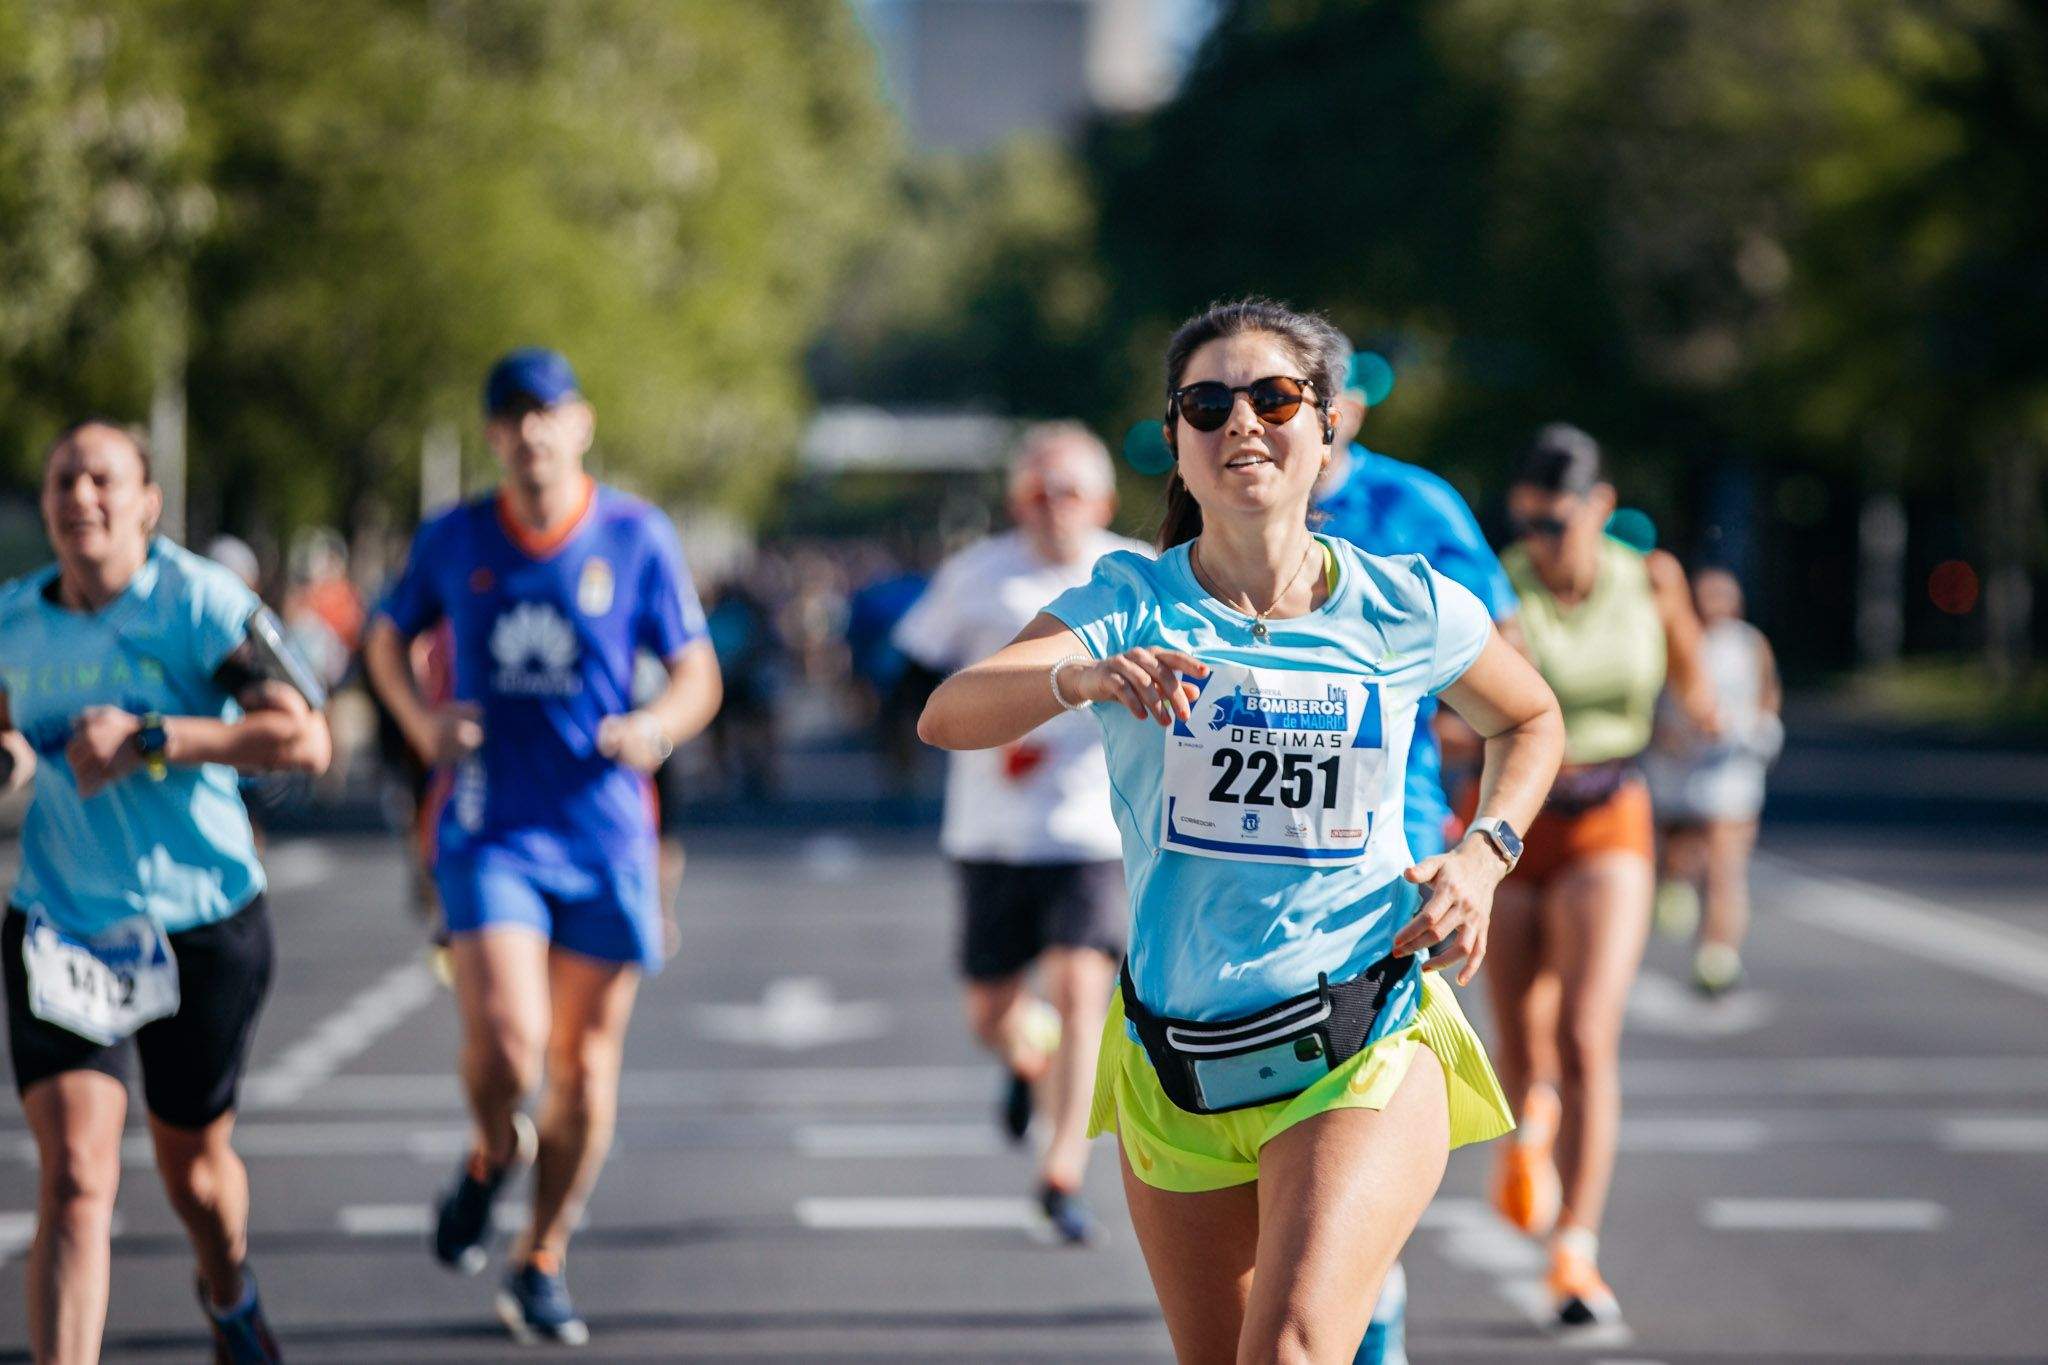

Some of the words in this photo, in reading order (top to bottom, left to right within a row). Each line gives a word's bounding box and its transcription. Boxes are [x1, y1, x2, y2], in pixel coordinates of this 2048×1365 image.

[1246, 697, 1345, 716] BOMBEROS
[1283, 714, 1297, 728] de
[1300, 714, 1346, 731] MADRID
[1231, 728, 1343, 748] DECIMAS
[1208, 747, 1341, 810] 2251
